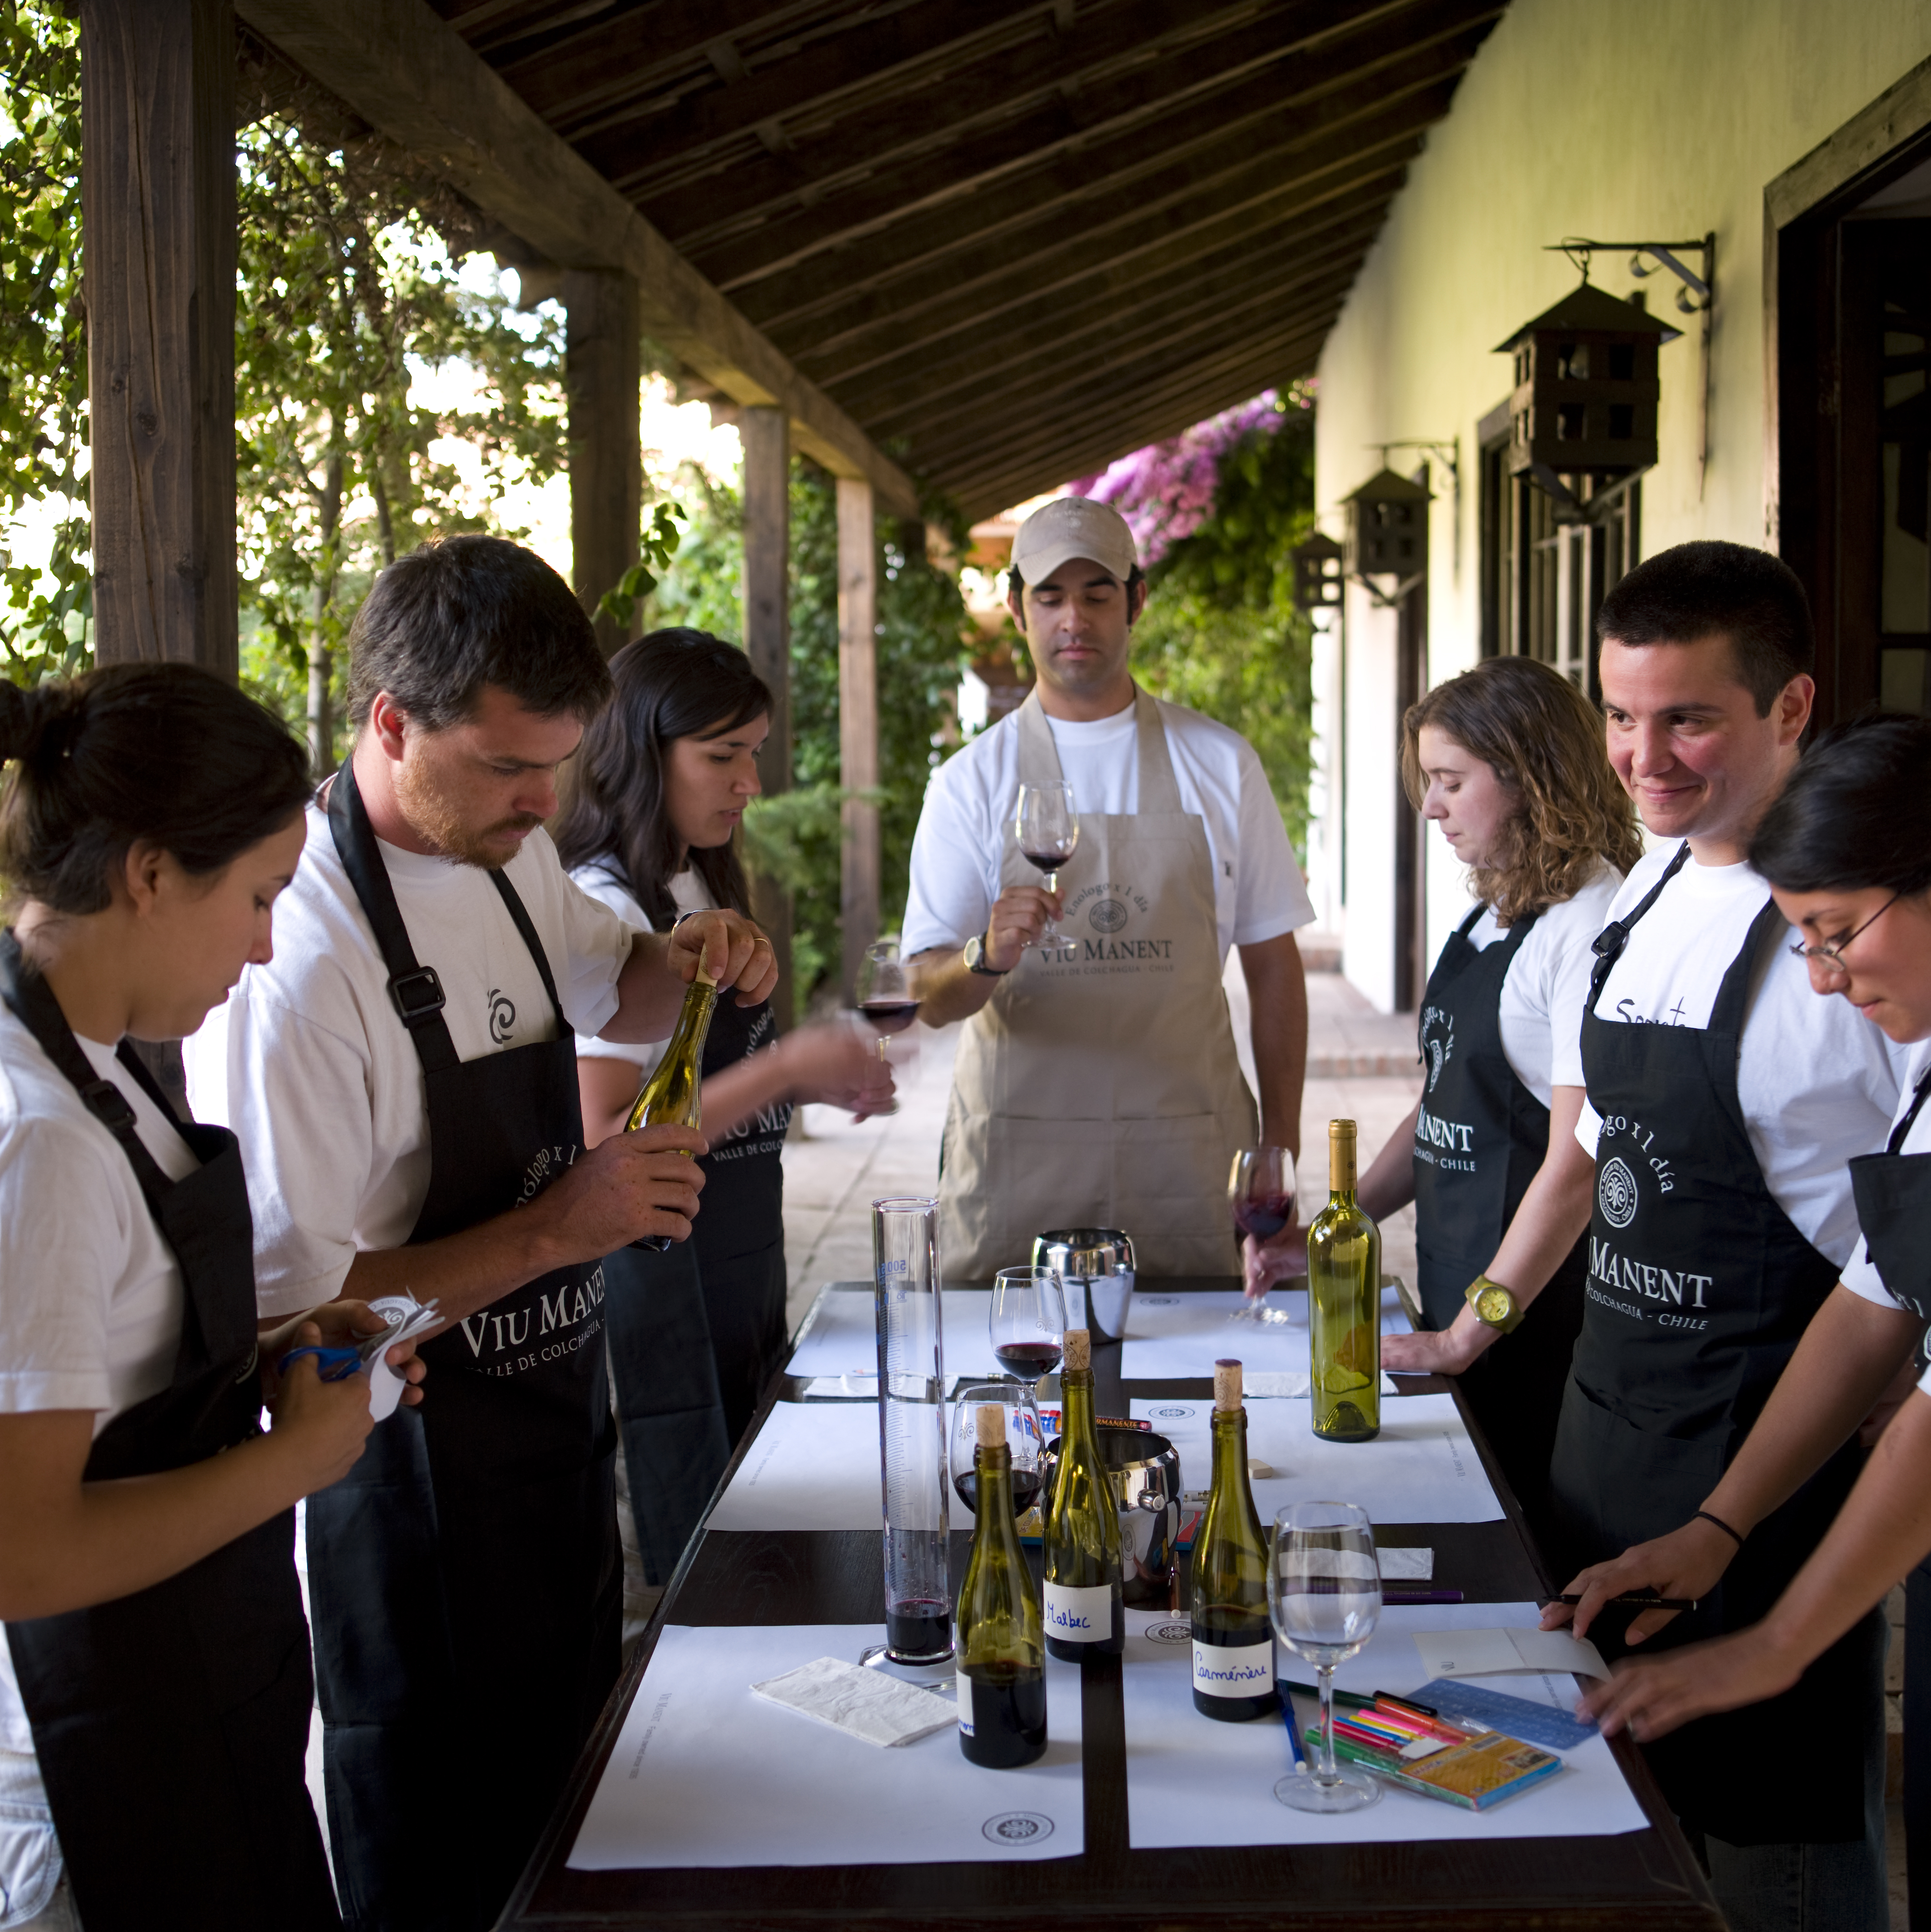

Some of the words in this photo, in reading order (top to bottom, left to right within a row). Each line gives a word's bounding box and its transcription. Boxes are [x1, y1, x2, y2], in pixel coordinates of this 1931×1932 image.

[1041, 949, 1076, 963] VIU
[1084, 938, 1172, 960] MANENT
[1040, 969, 1065, 977] VALLE
[1084, 965, 1140, 975] COLCHAGUA
[554, 1147, 562, 1161] x
[712, 1147, 744, 1161] VALLE
[746, 1144, 758, 1156] DE
[1440, 1157, 1475, 1172] CHILE
[1631, 1122, 1641, 1139] x
[1649, 1158, 1675, 1193] día
[1590, 1236, 1713, 1308] MANENT
[1589, 1288, 1644, 1320] COLCHAGUA
[1658, 1314, 1709, 1330] CHILE
[460, 1312, 531, 1358] VIU
[518, 1353, 537, 1371] DE
[542, 1319, 601, 1361] COLCHAGUA
[1047, 1600, 1090, 1628] Malbec
[1195, 1651, 1266, 1682] Carménière
